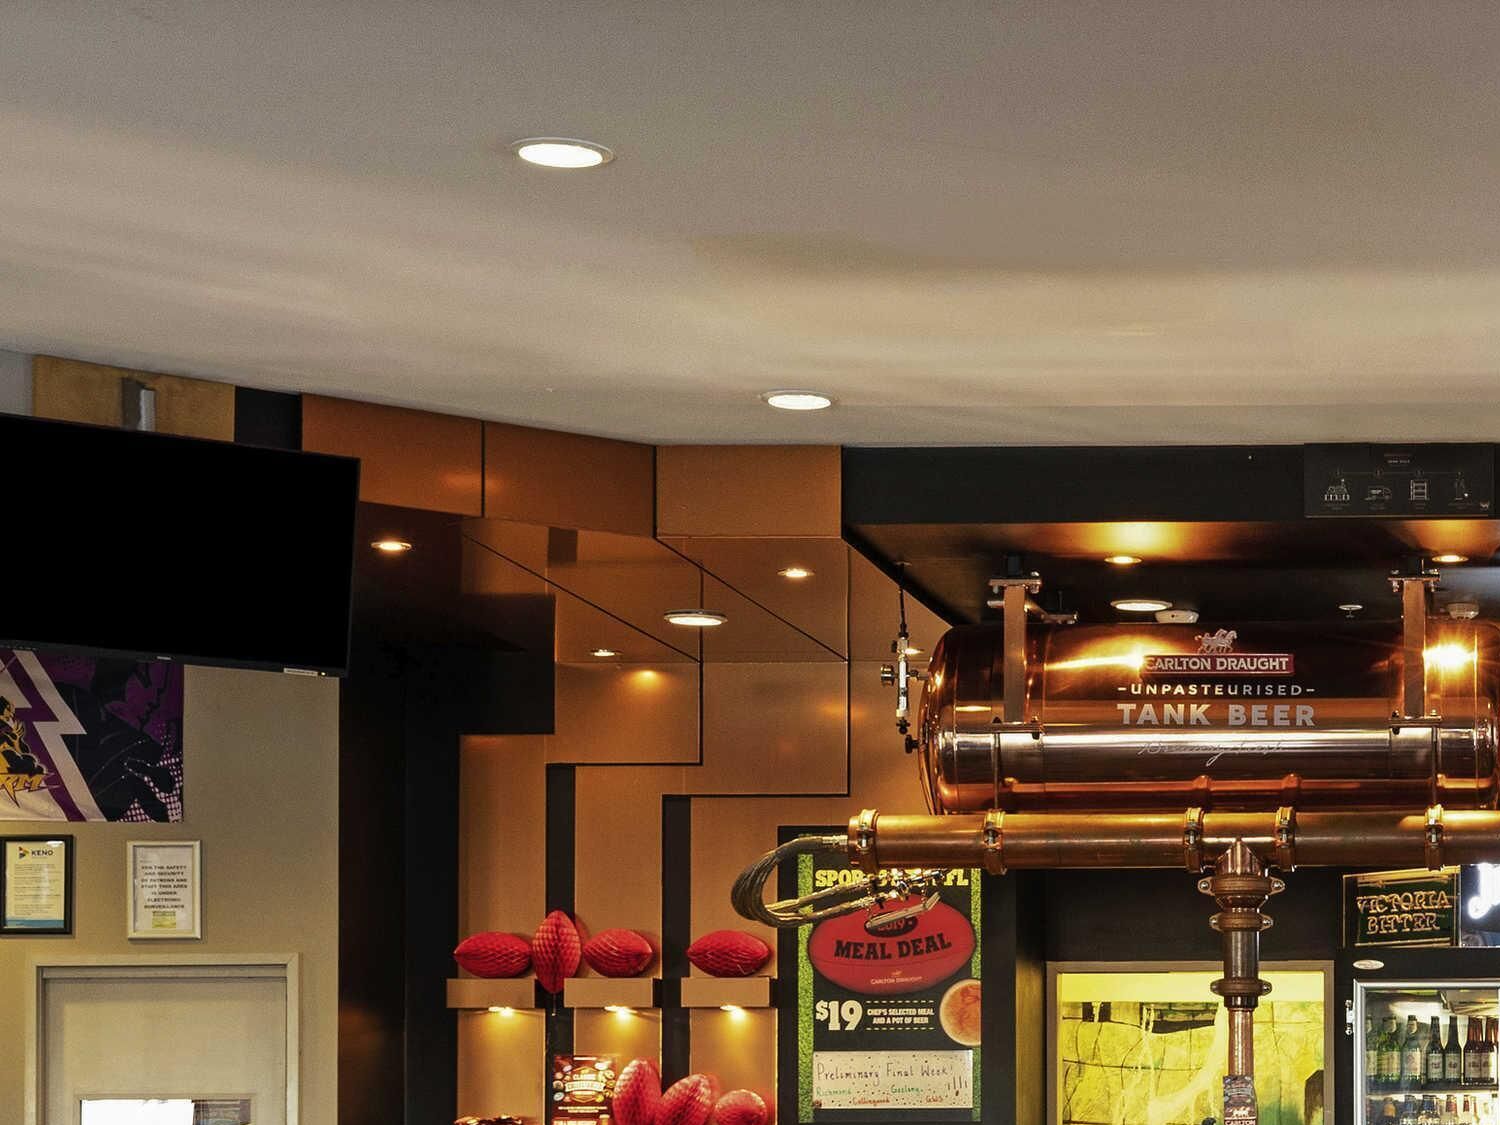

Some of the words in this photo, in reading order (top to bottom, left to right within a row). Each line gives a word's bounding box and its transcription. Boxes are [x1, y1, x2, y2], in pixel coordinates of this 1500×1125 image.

[1144, 656, 1211, 671] CARLTON
[1215, 656, 1289, 670] DRAUGHT
[1116, 703, 1212, 726] TANK
[1228, 703, 1316, 727] BEER
[815, 869, 889, 888] SPORS
[1356, 890, 1452, 914] VICTORIA
[1366, 912, 1440, 934] BITTER
[834, 940, 892, 960] MEAL
[897, 933, 952, 958] DEAL
[815, 1000, 863, 1031] $19
[917, 1008, 935, 1016] MEAL
[817, 1063, 880, 1086] Preliminary
[886, 1062, 914, 1078] Final
